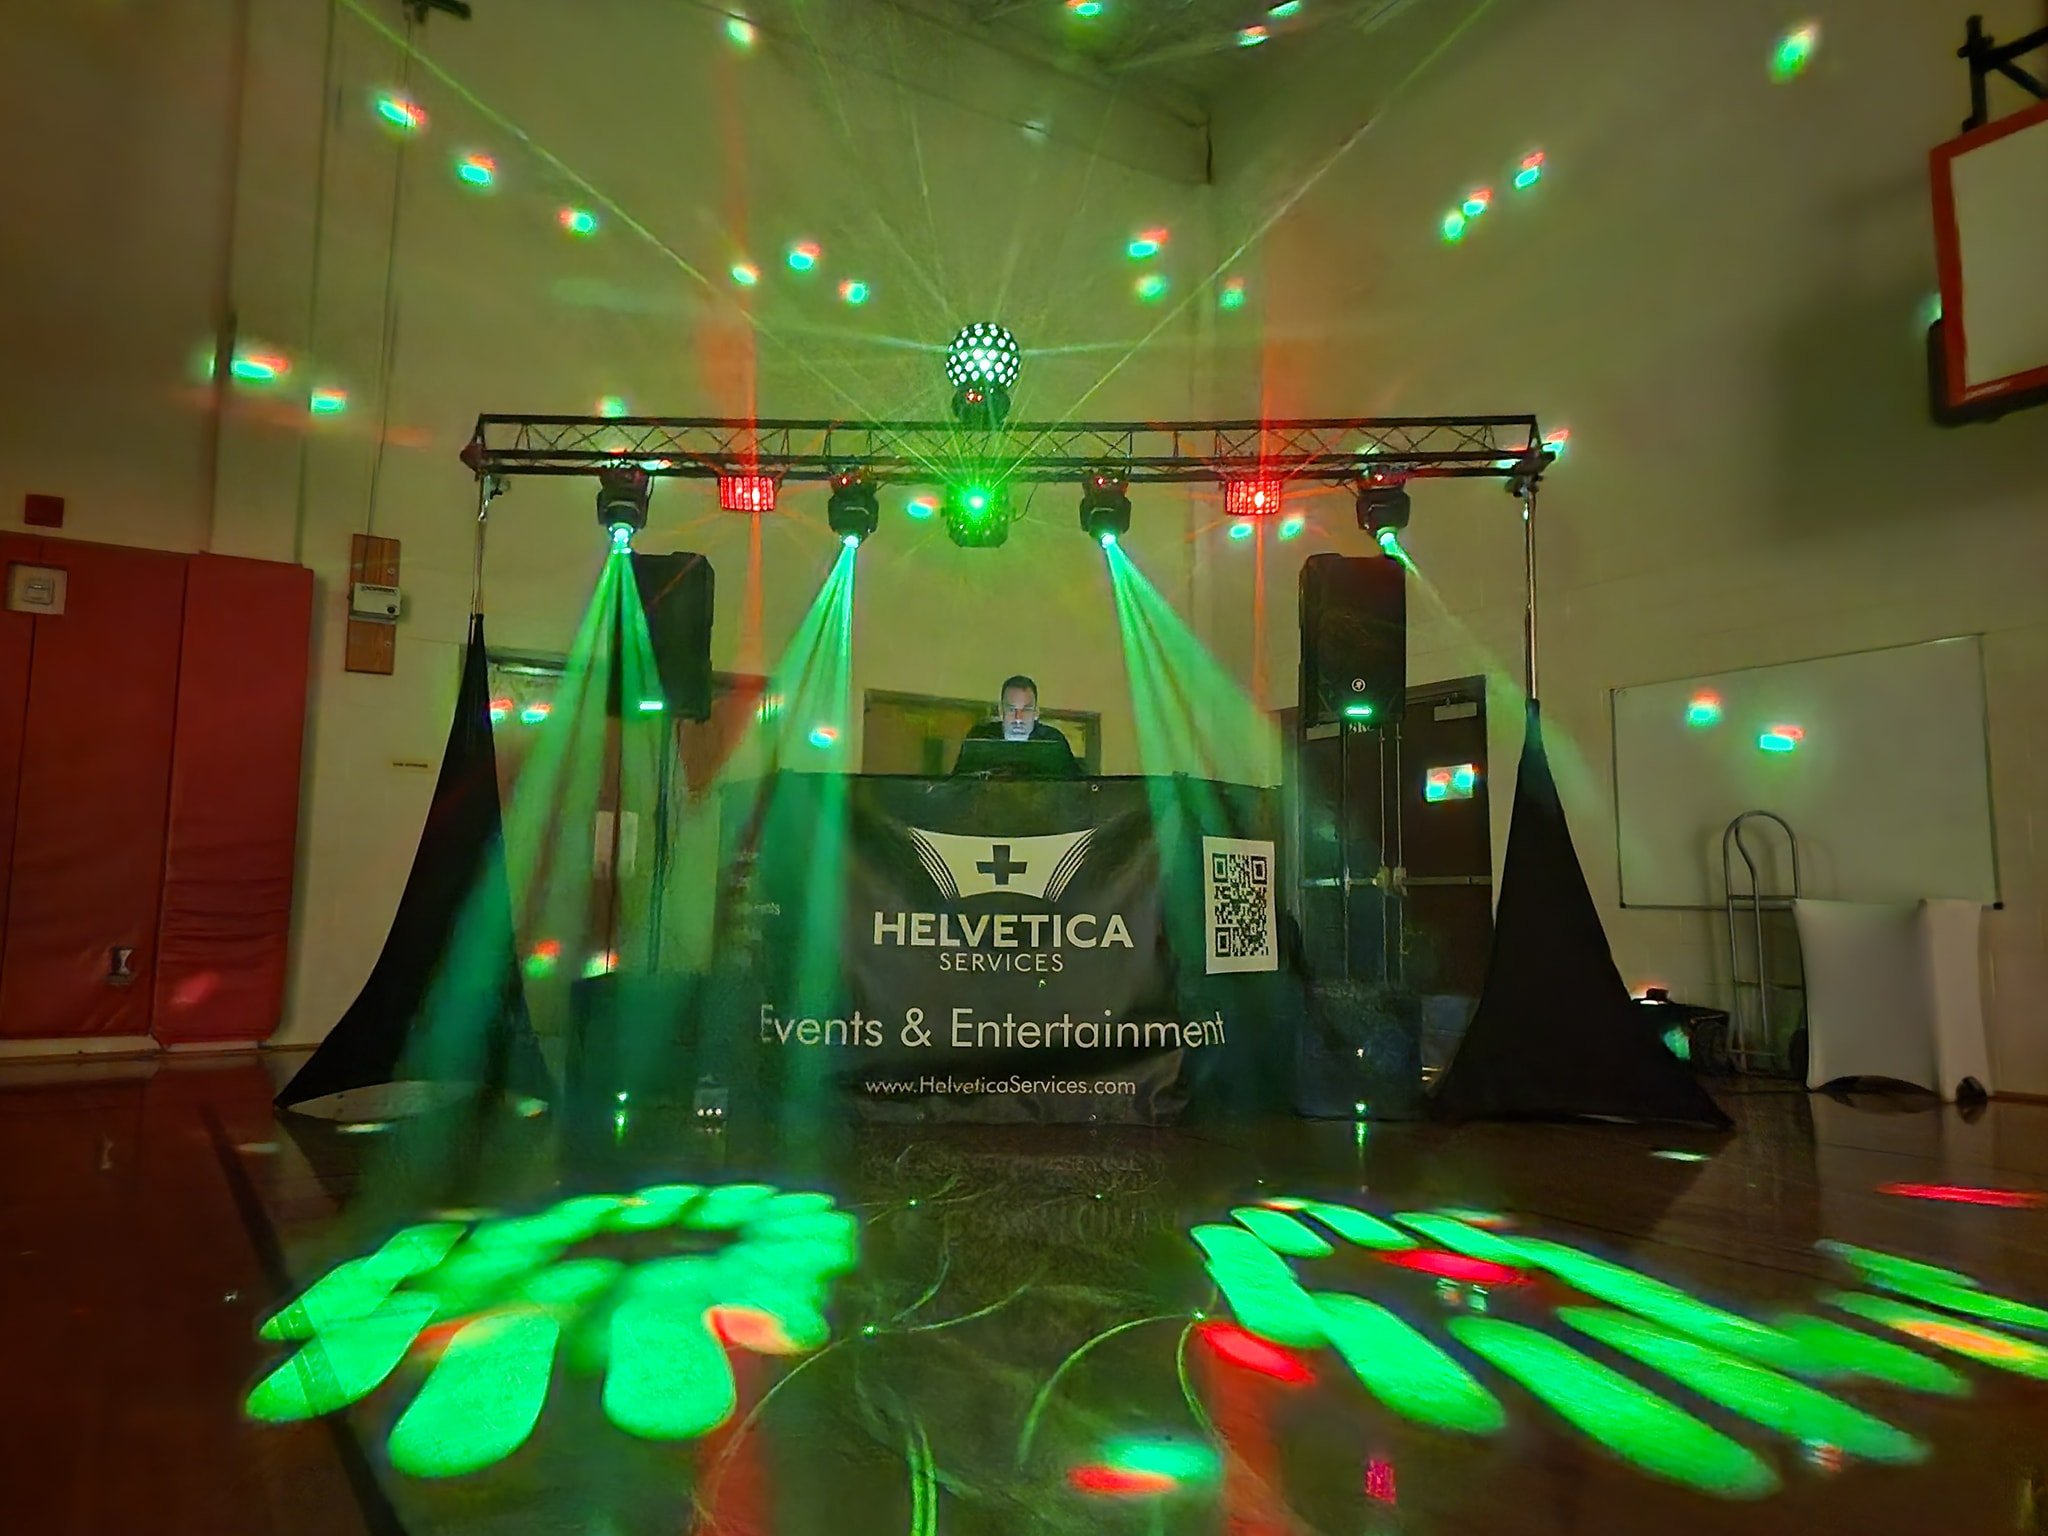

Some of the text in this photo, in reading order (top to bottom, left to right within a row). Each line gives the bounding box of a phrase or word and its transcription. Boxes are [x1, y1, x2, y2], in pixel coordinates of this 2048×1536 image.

[873, 911, 1134, 948] HELVETICA
[939, 952, 1064, 972] SERVICES
[761, 1003, 1225, 1048] Events & Entertainment
[865, 1075, 1136, 1095] www.HelveticaServices.com
